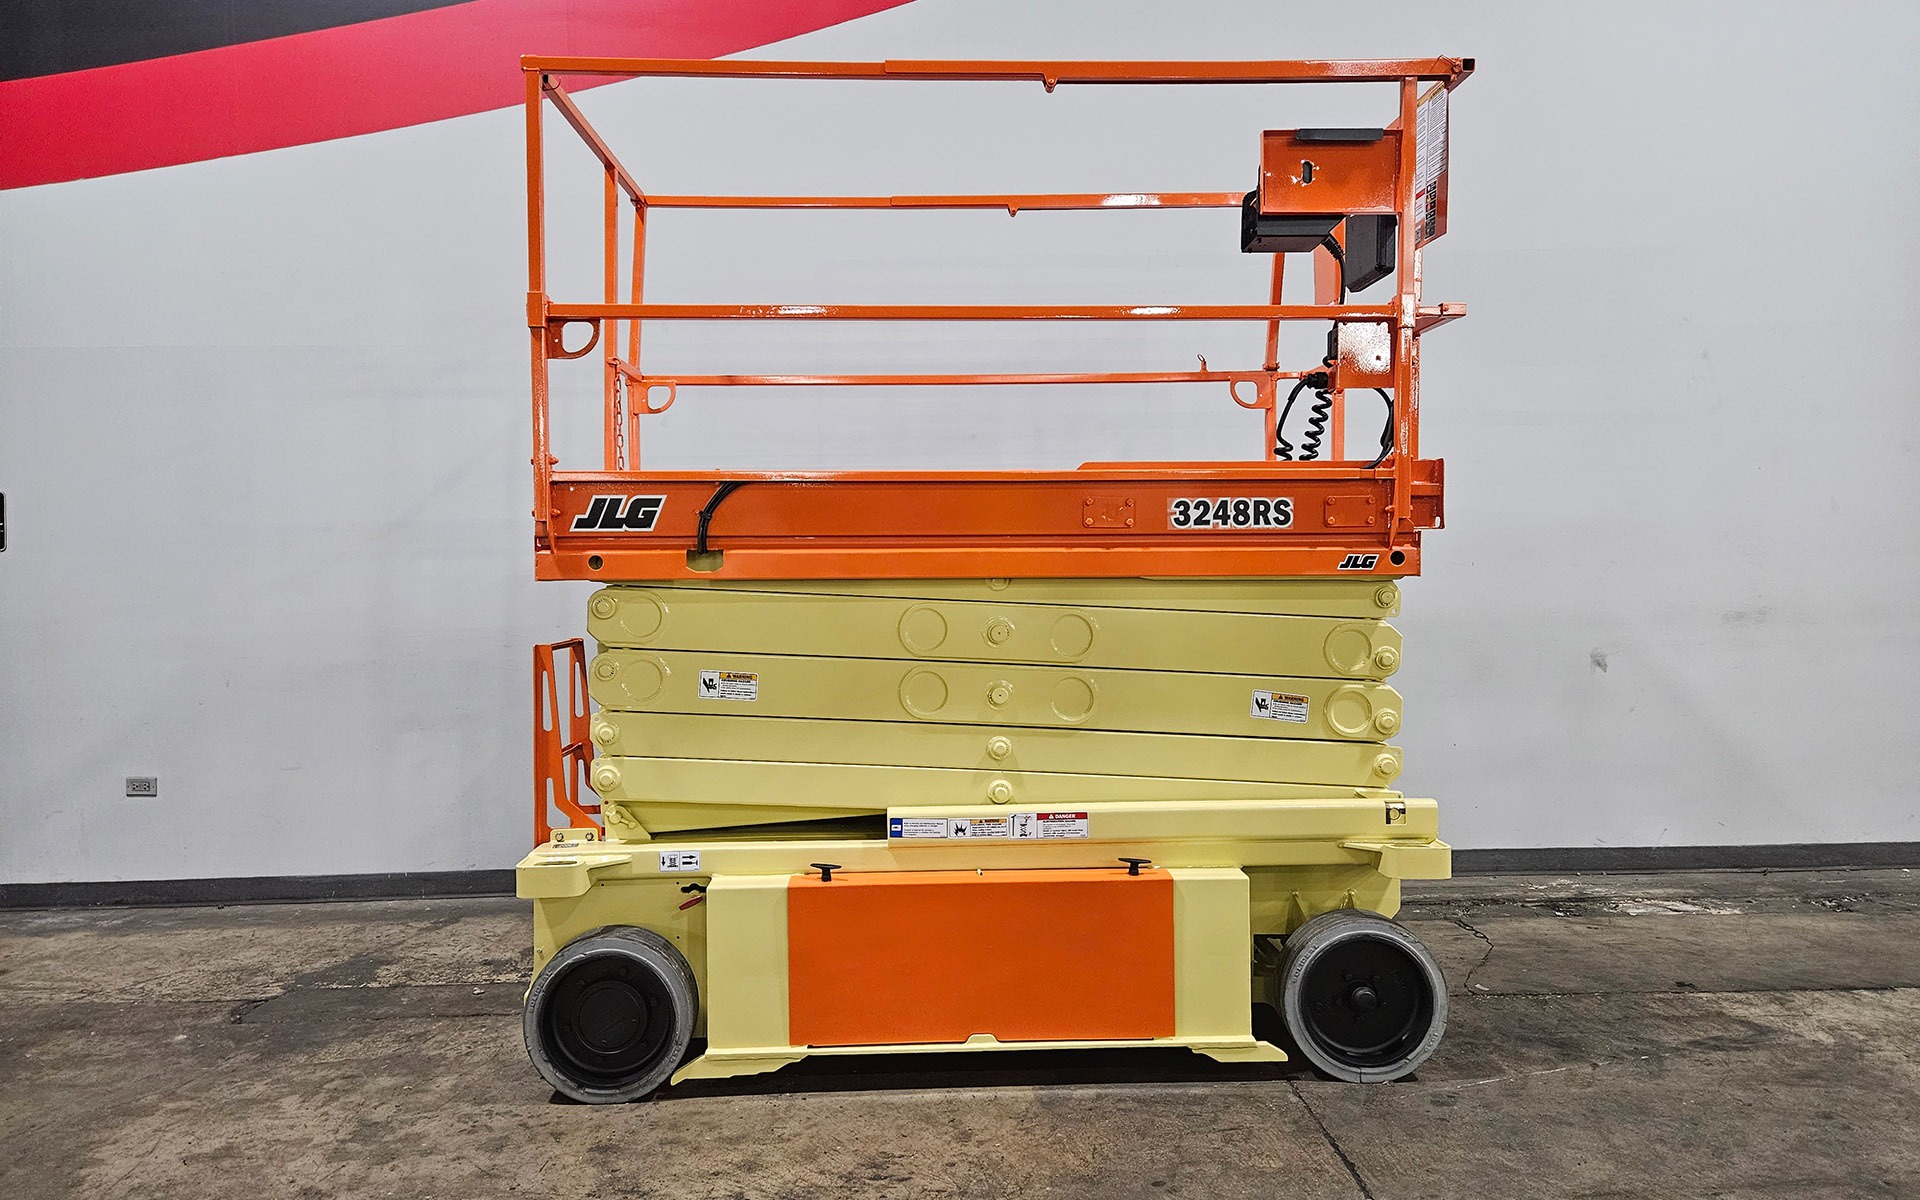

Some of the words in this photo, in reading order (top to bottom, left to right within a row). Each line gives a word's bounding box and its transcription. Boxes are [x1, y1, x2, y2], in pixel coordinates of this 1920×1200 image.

[570, 495, 666, 531] JLG
[1172, 498, 1292, 528] 3248RS
[1338, 554, 1379, 570] JLG
